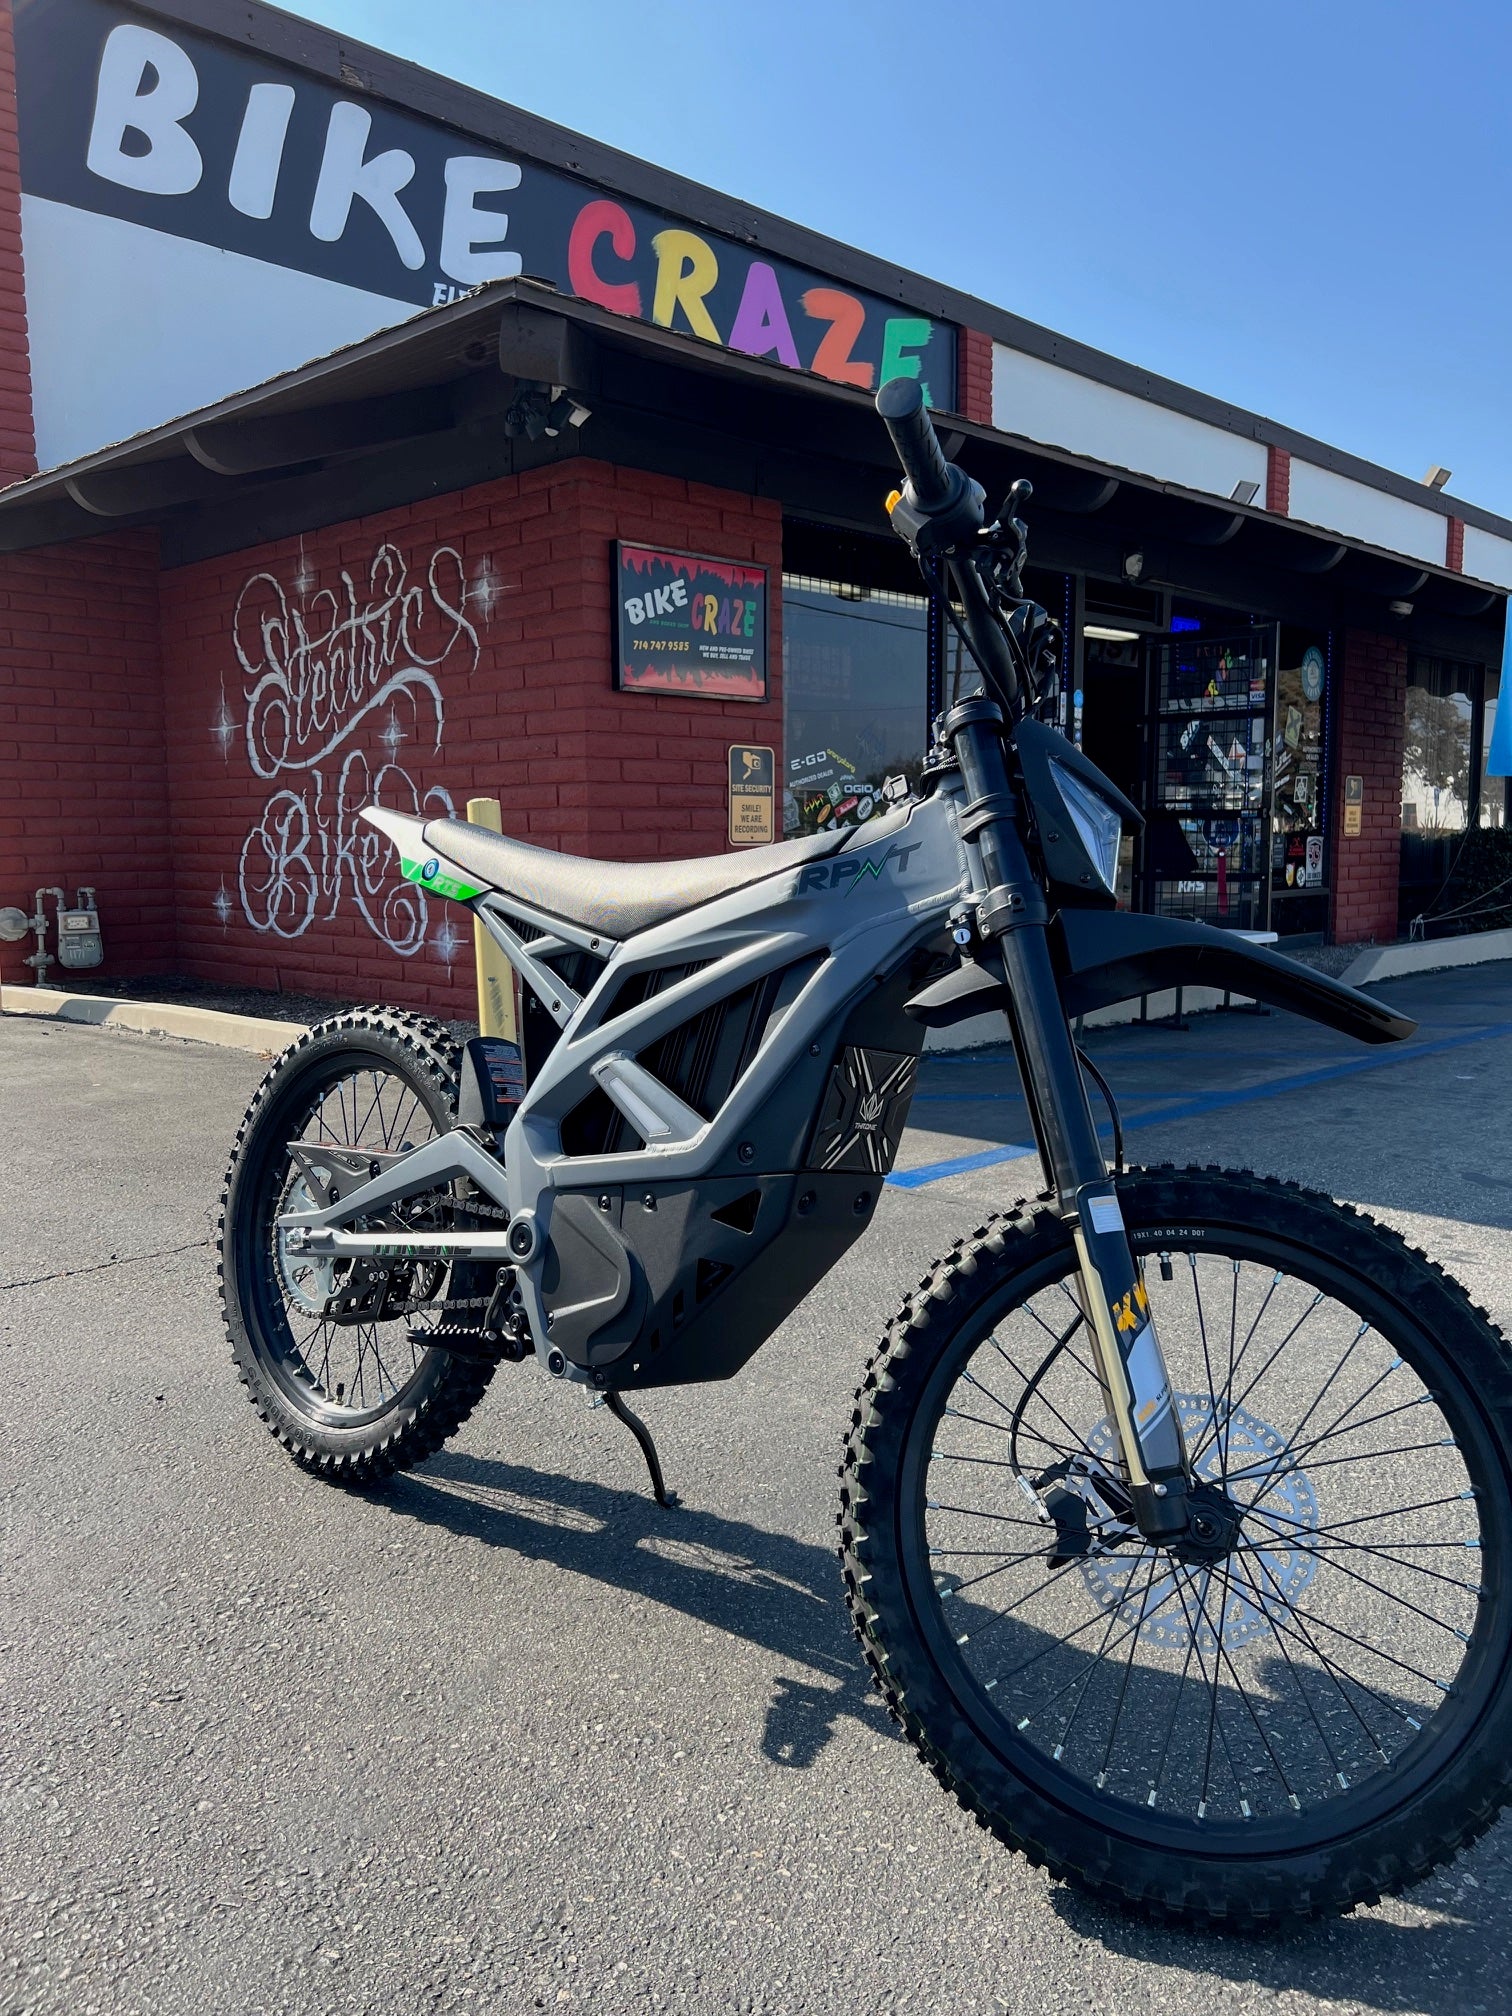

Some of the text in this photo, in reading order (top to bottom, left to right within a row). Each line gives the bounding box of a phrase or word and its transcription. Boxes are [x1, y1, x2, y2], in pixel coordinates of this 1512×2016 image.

[87, 24, 934, 408] BIKE CRAZE
[624, 578, 757, 637] BIKE CRAZE
[633, 640, 690, 651] 714 747 9585
[789, 774, 817, 788] AUTHORIZED
[817, 769, 834, 780] DEALER
[731, 783, 772, 793] SITE SECURITY
[844, 784, 873, 793] OGIO
[741, 804, 761, 812] SMILE!
[740, 815, 762, 823] WE ARE
[735, 825, 768, 834] RECORDING
[854, 1122, 878, 1131] THRONE
